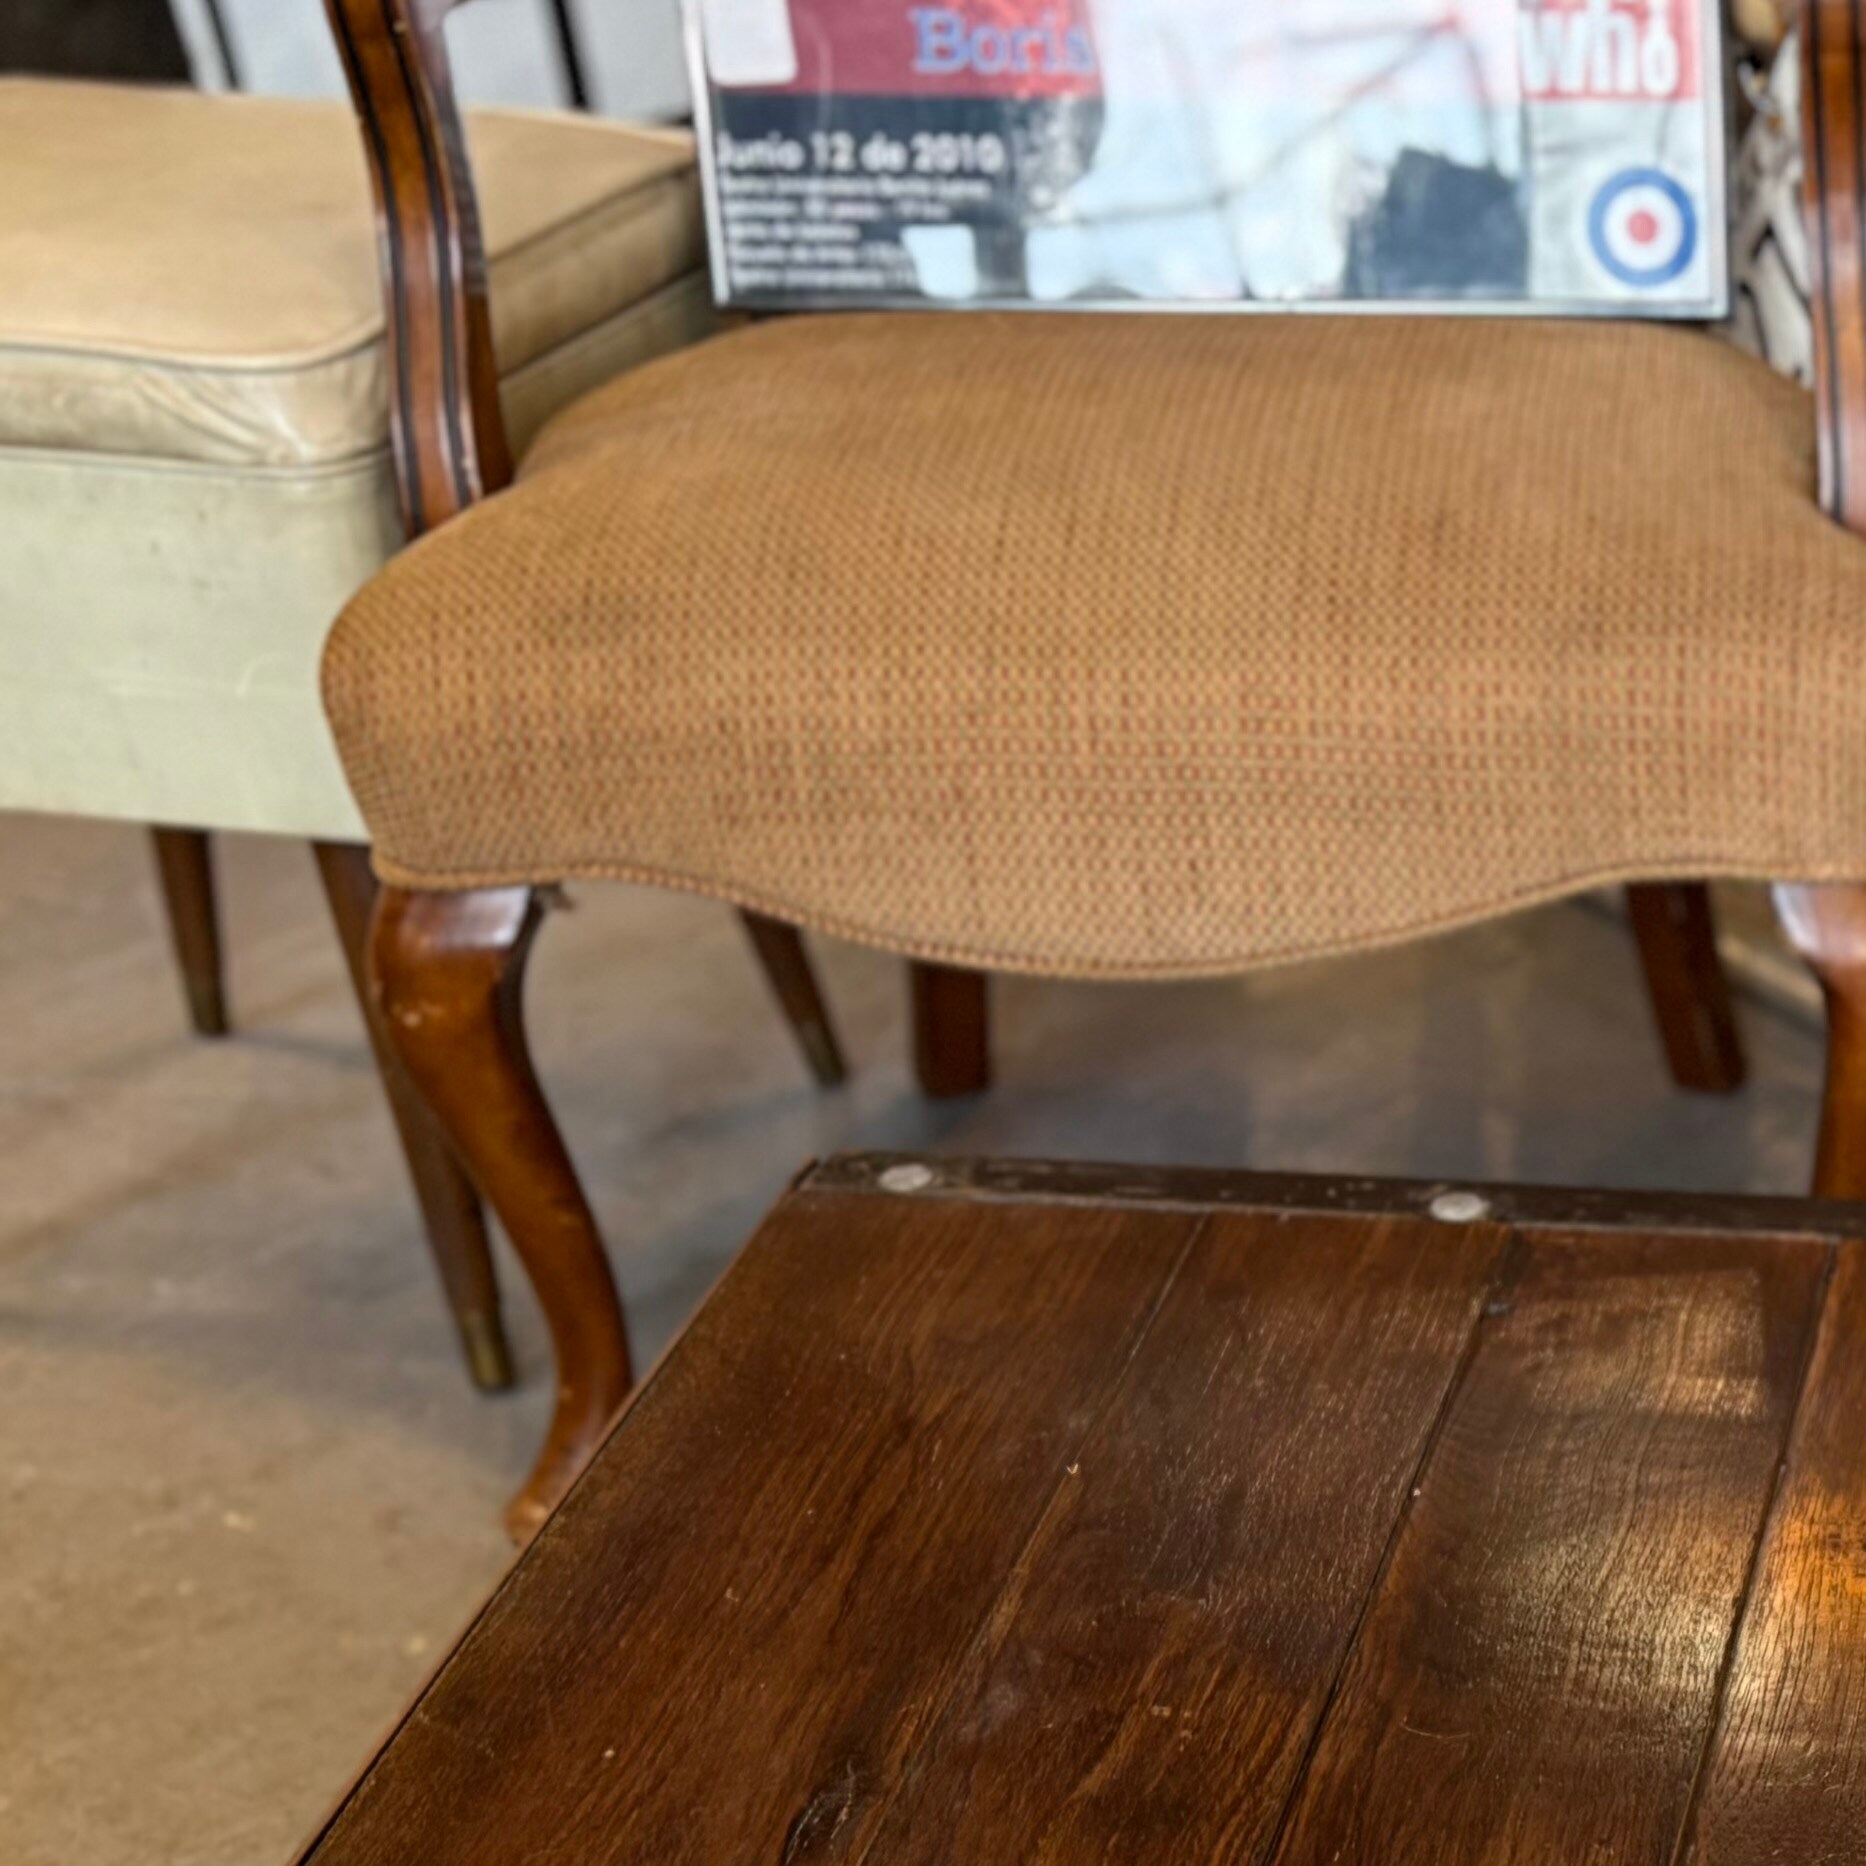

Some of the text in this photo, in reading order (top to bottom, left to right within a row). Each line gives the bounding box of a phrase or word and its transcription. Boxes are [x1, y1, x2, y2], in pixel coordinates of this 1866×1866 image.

[909, 6, 1095, 75] Boris
[811, 130, 854, 172] 12
[861, 130, 907, 173] de
[911, 131, 1005, 174] 2010
